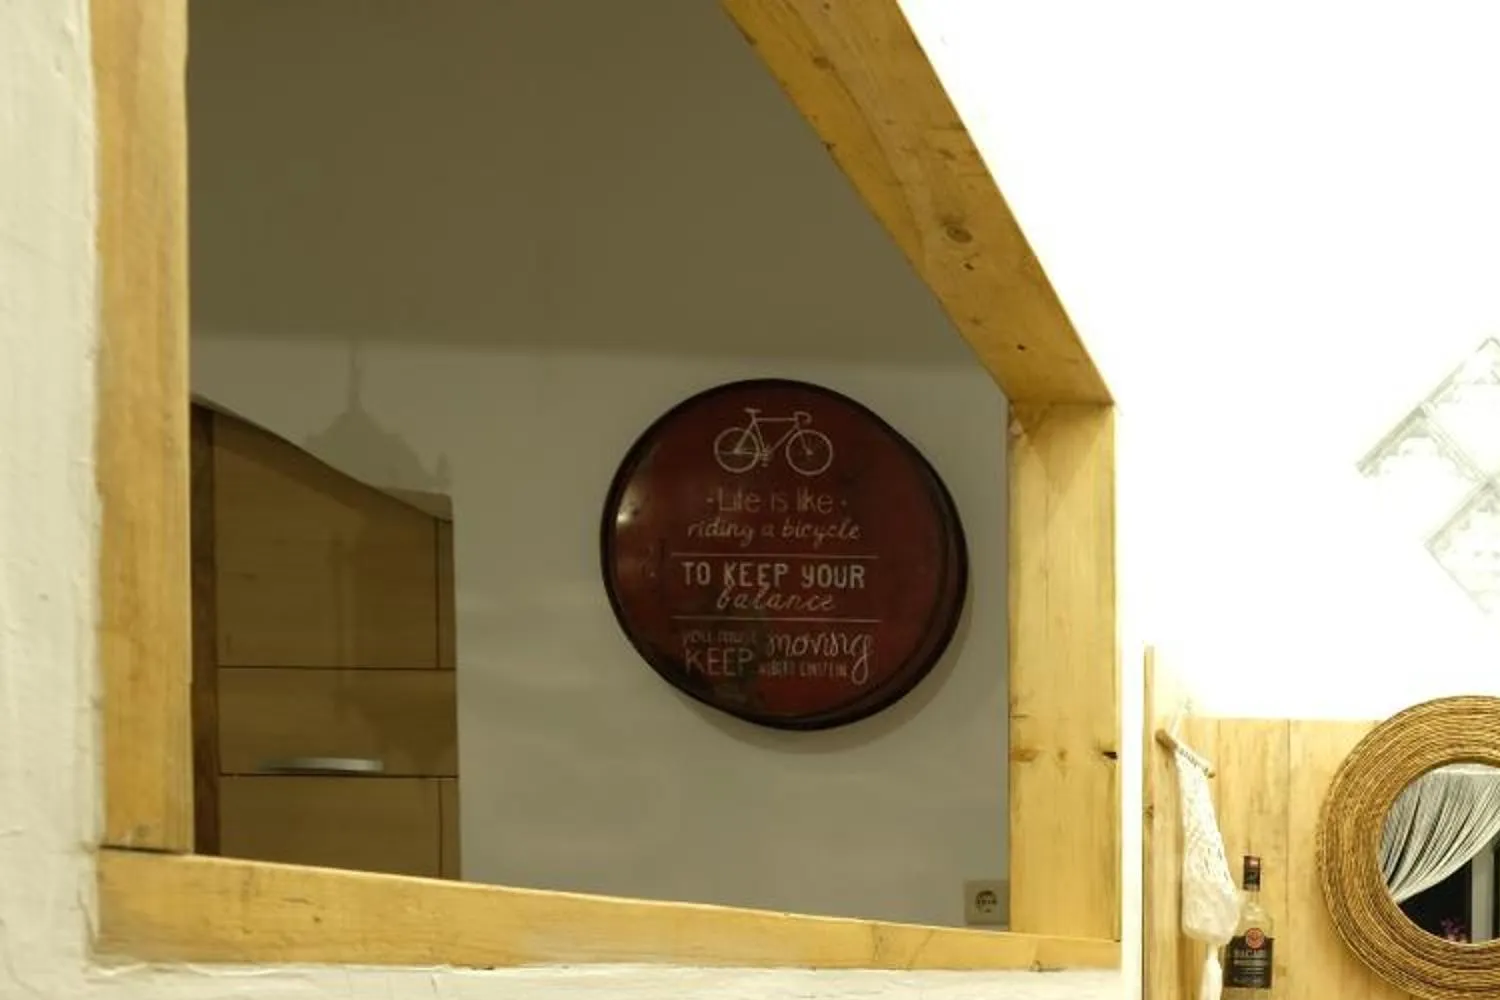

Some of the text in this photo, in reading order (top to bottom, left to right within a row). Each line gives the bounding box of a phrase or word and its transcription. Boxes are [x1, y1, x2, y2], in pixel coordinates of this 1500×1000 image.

[771, 489, 789, 514] is
[687, 516, 862, 549] riding a bicycle
[681, 561, 711, 586] TO
[723, 560, 789, 587] KEEP
[716, 581, 836, 611] balance
[717, 629, 757, 644] mut
[685, 648, 754, 677] KEEP
